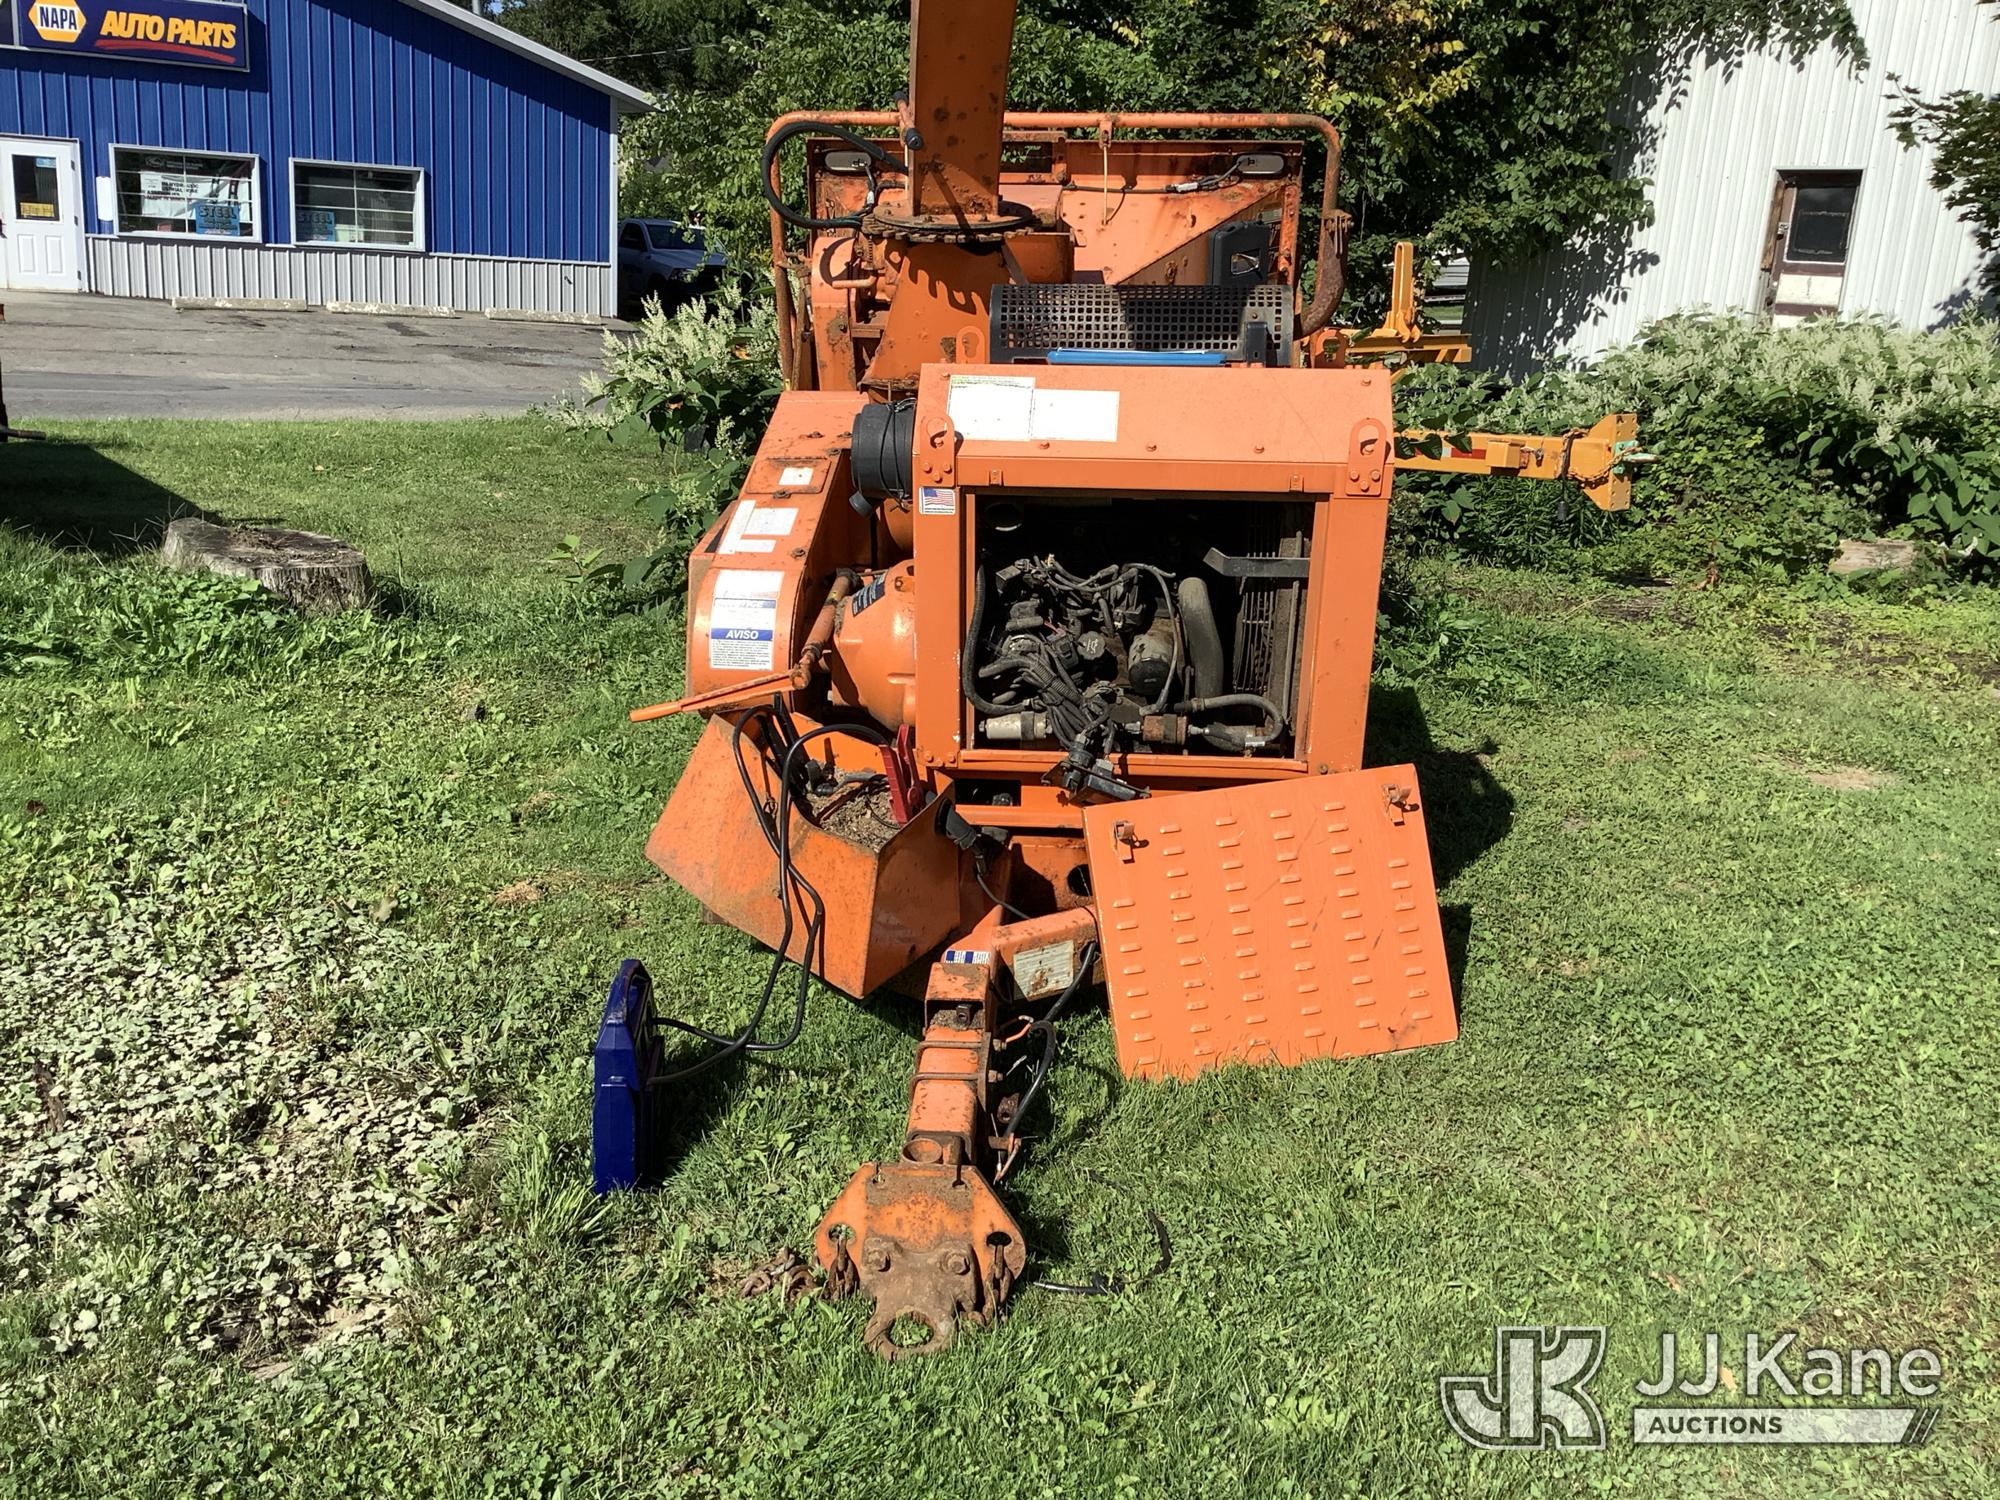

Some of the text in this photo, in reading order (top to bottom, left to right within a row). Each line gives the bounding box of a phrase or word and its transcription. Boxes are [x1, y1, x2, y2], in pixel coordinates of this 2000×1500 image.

[38, 6, 237, 49] NAPA AUTO PARTS
[199, 205, 237, 219] STEEL
[725, 629, 760, 640] AVISO
